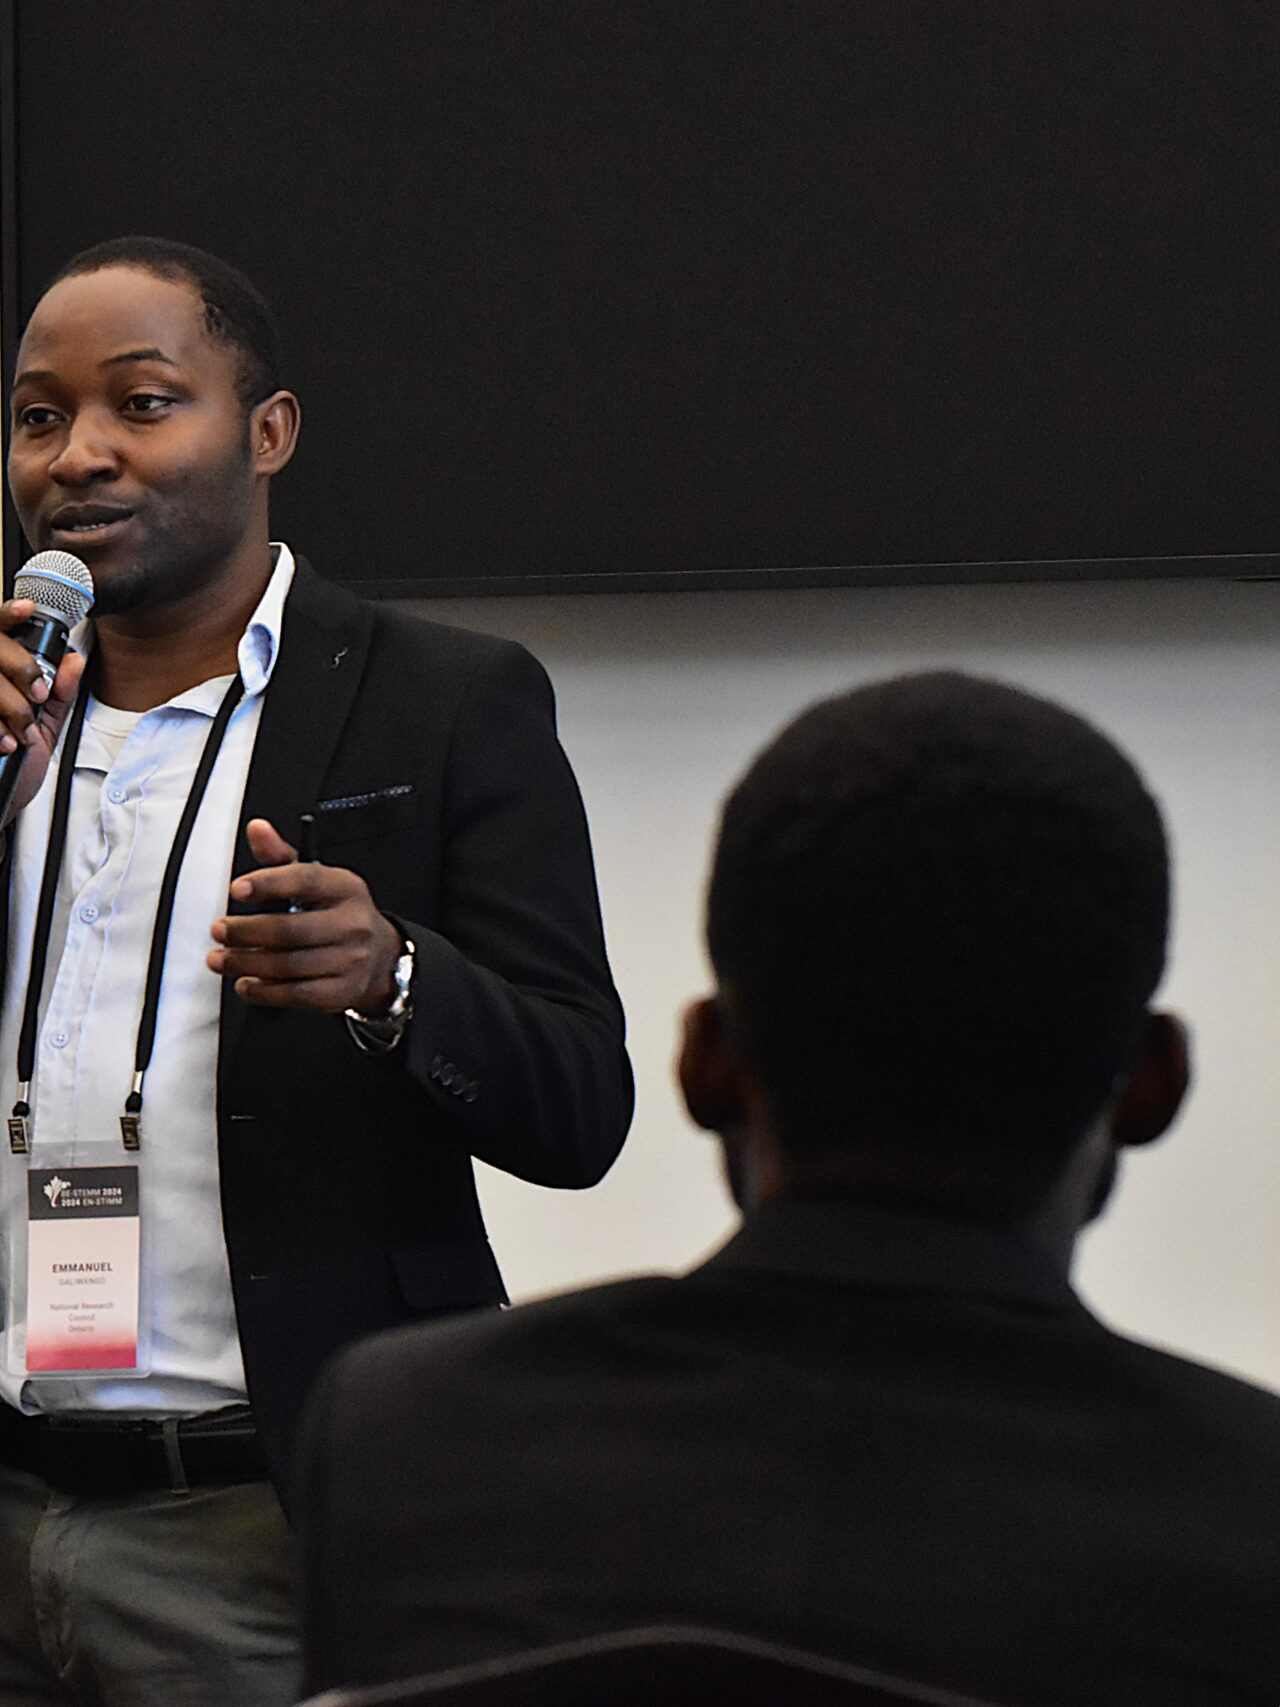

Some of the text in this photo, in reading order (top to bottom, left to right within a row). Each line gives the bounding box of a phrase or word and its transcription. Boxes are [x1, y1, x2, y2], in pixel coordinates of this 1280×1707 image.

[102, 1187, 122, 1196] 2024
[61, 1198, 81, 1207] 2024
[52, 1262, 113, 1273] EMMANUEL
